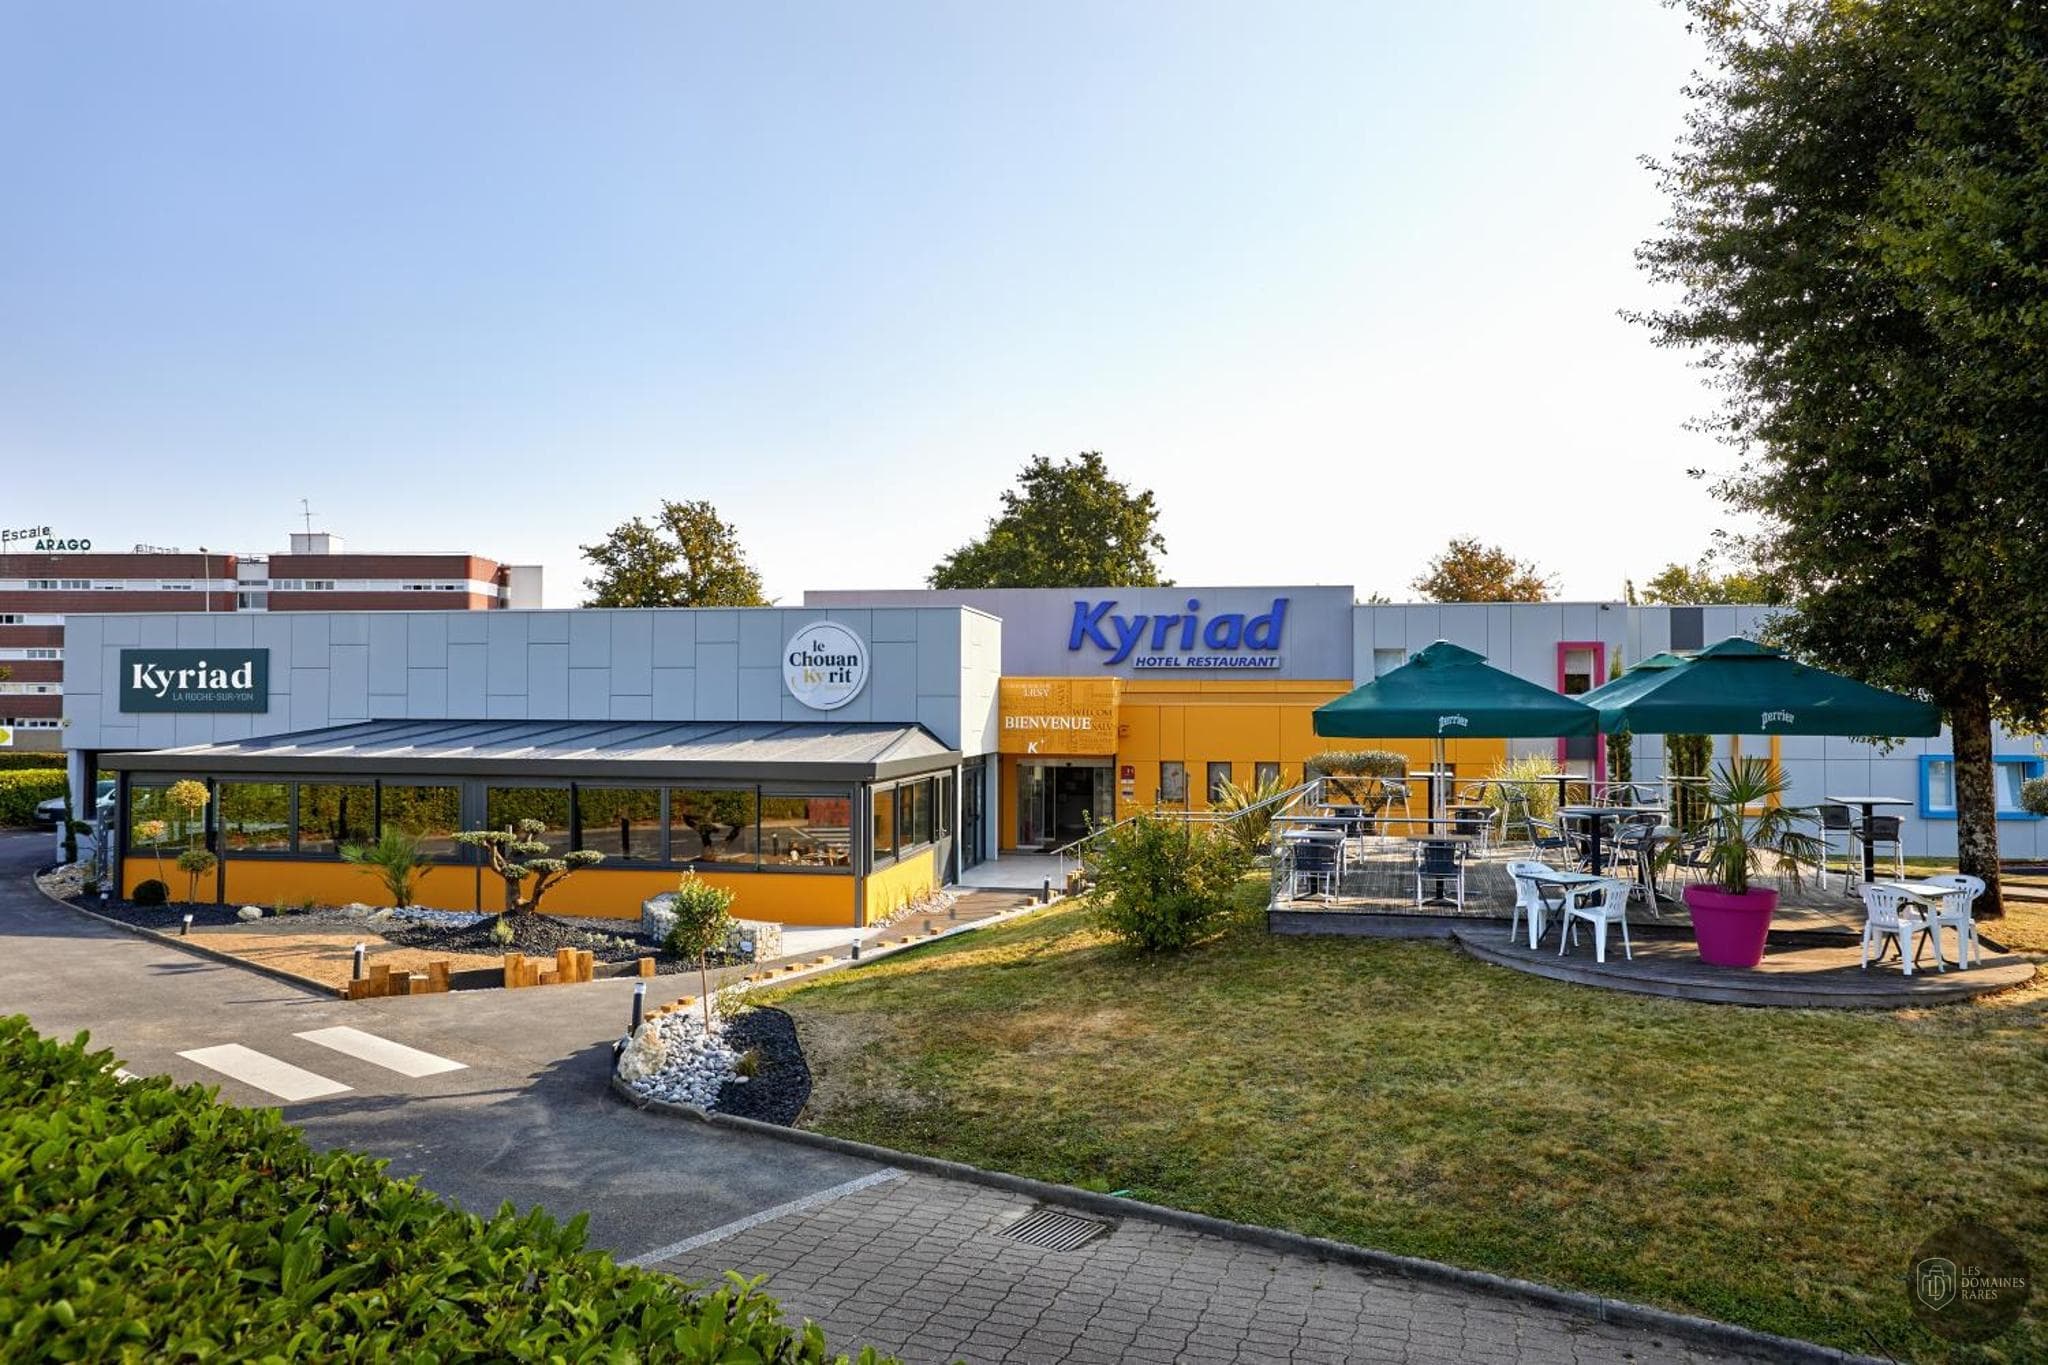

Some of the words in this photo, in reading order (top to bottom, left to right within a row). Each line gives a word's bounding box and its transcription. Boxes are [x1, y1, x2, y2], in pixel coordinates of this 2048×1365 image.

[2, 525, 50, 541] Escale
[35, 539, 91, 550] ARAGO
[1068, 598, 1289, 665] Kyriad
[813, 640, 825, 652] le
[789, 651, 858, 667] Chouan
[1135, 657, 1180, 667] HOTEL
[1186, 657, 1276, 667] RESTAURANT
[132, 661, 253, 698] Kyriad
[172, 692, 184, 701] LA
[185, 692, 254, 701] ROCHE-SUR-YON
[1005, 716, 1091, 729] BIENVENUE
